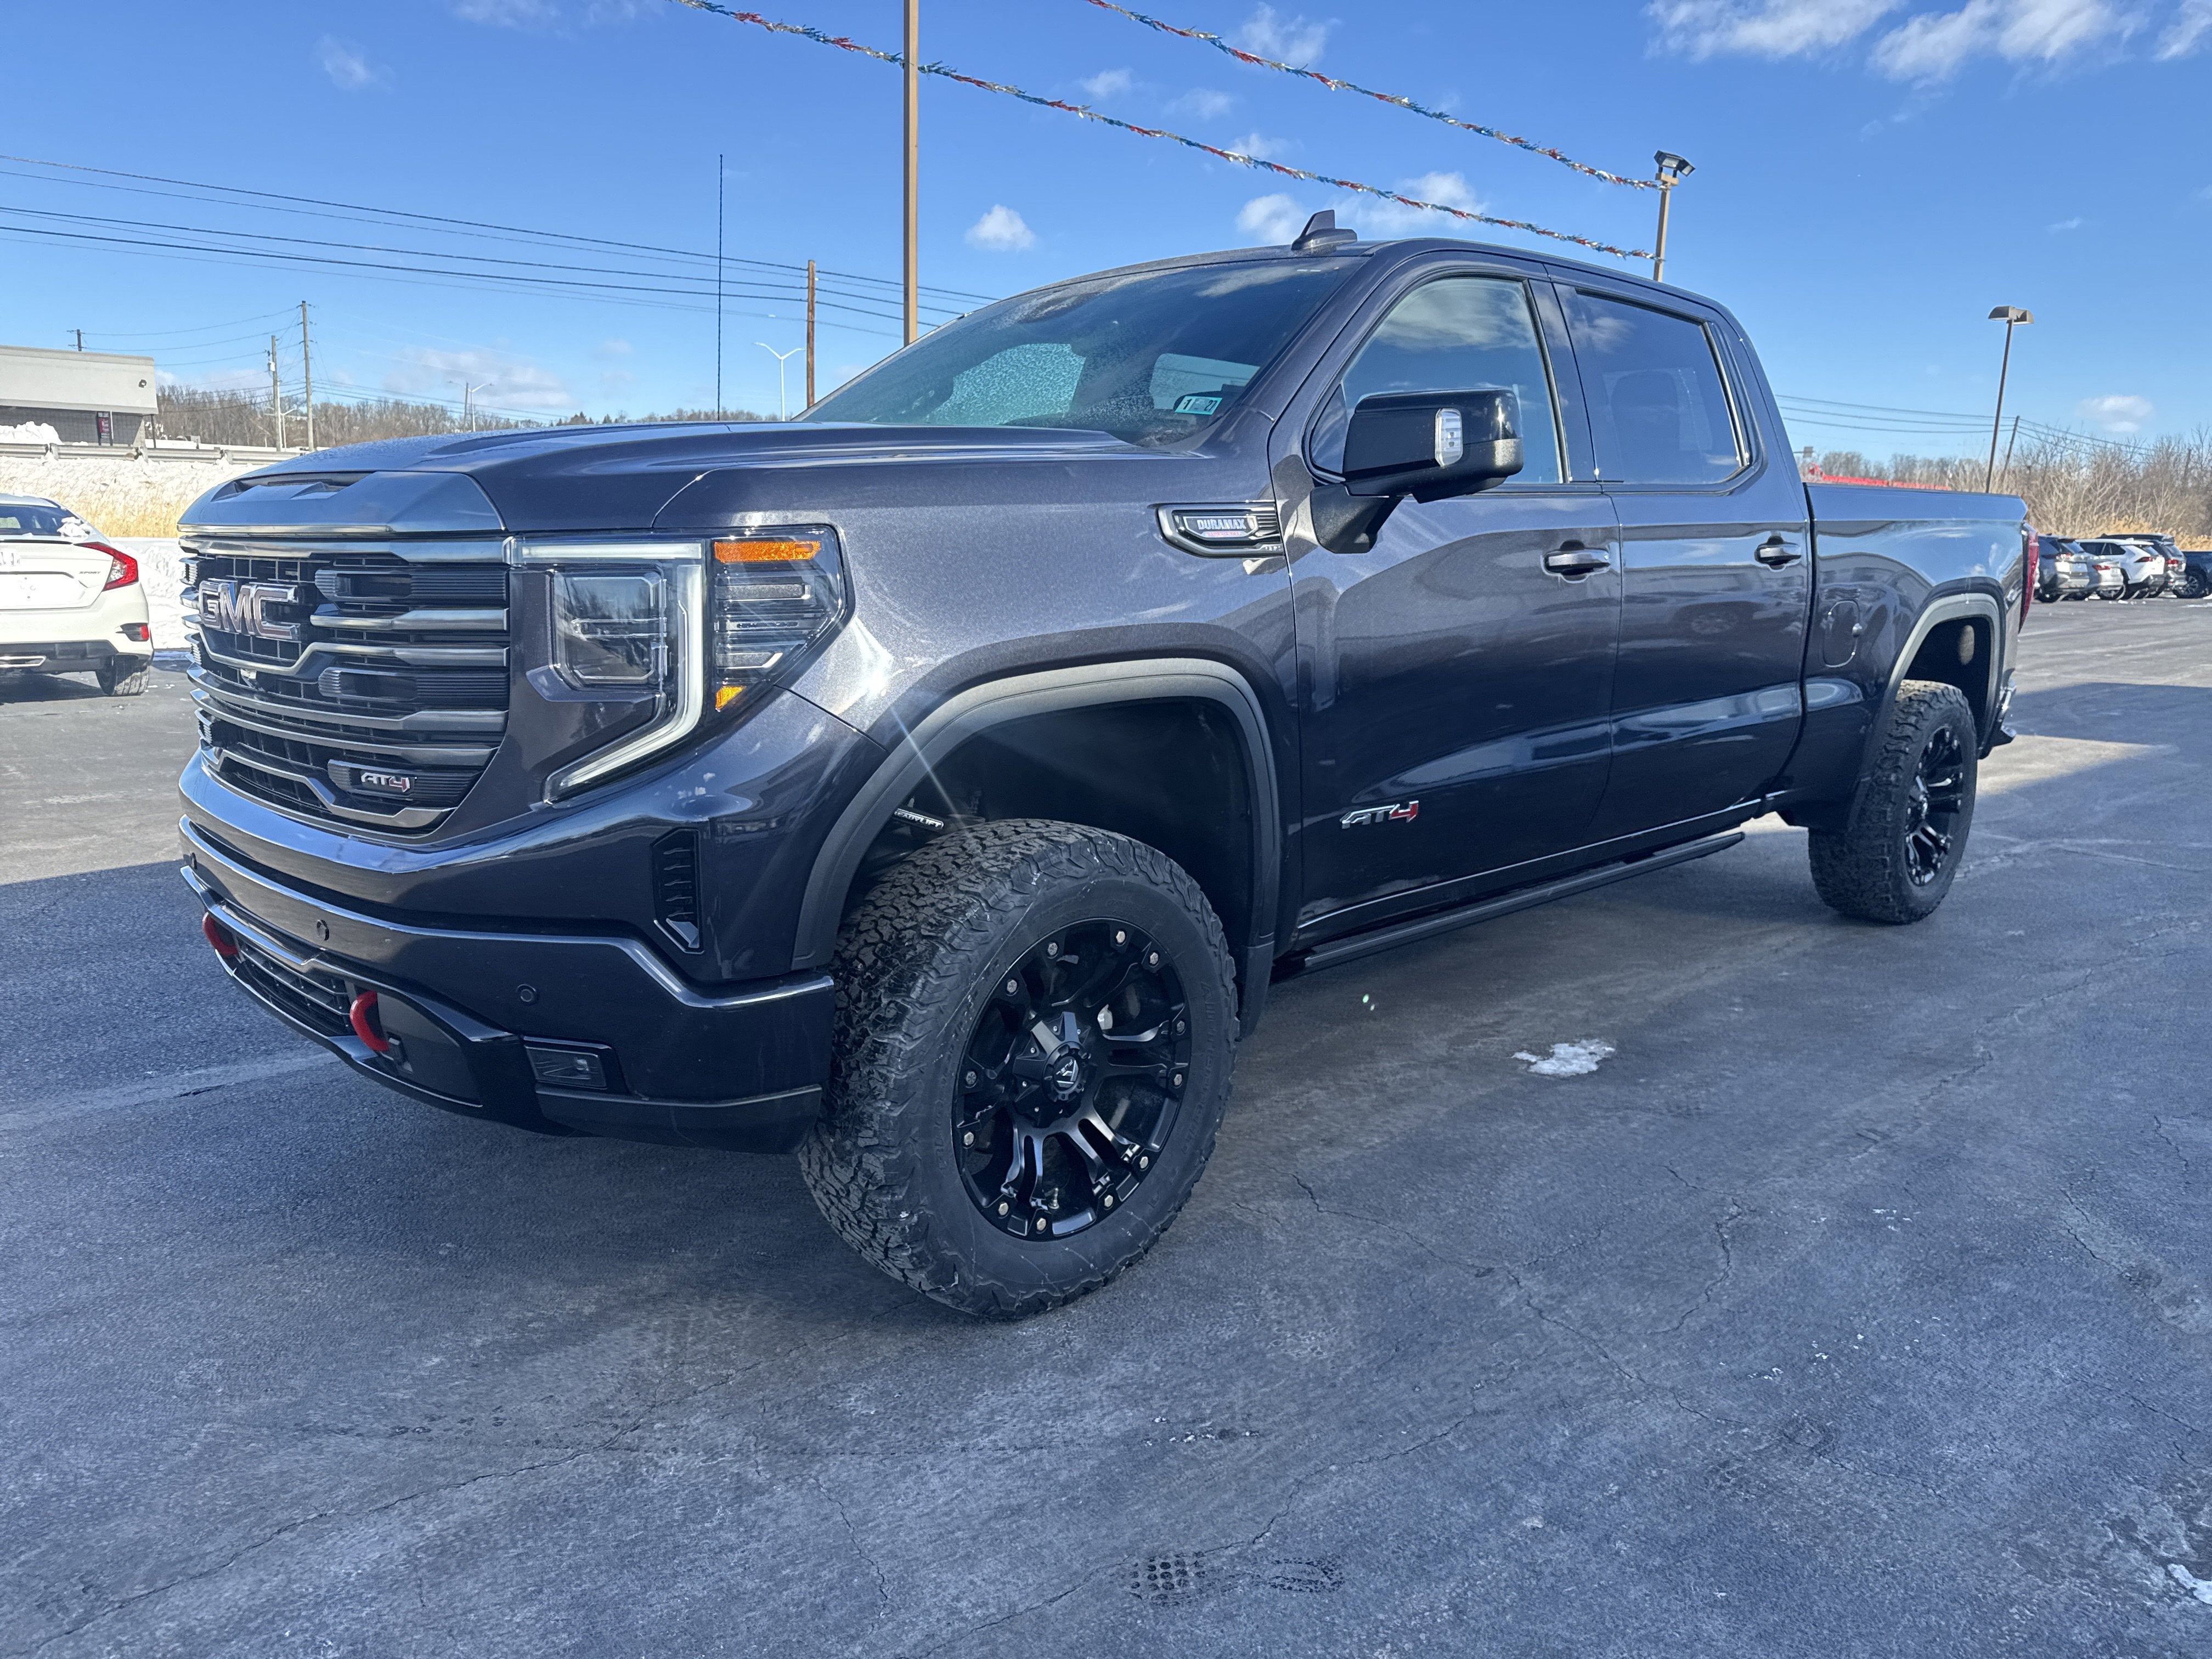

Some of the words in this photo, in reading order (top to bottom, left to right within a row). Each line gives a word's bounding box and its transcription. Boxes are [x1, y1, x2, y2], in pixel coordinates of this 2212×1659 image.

[1197, 518, 1246, 530] DURAMAX
[198, 577, 298, 640] GMC
[360, 772, 410, 792] AT4
[1339, 800, 1419, 830] AT4
[1056, 1059, 1073, 1075] FUEL
